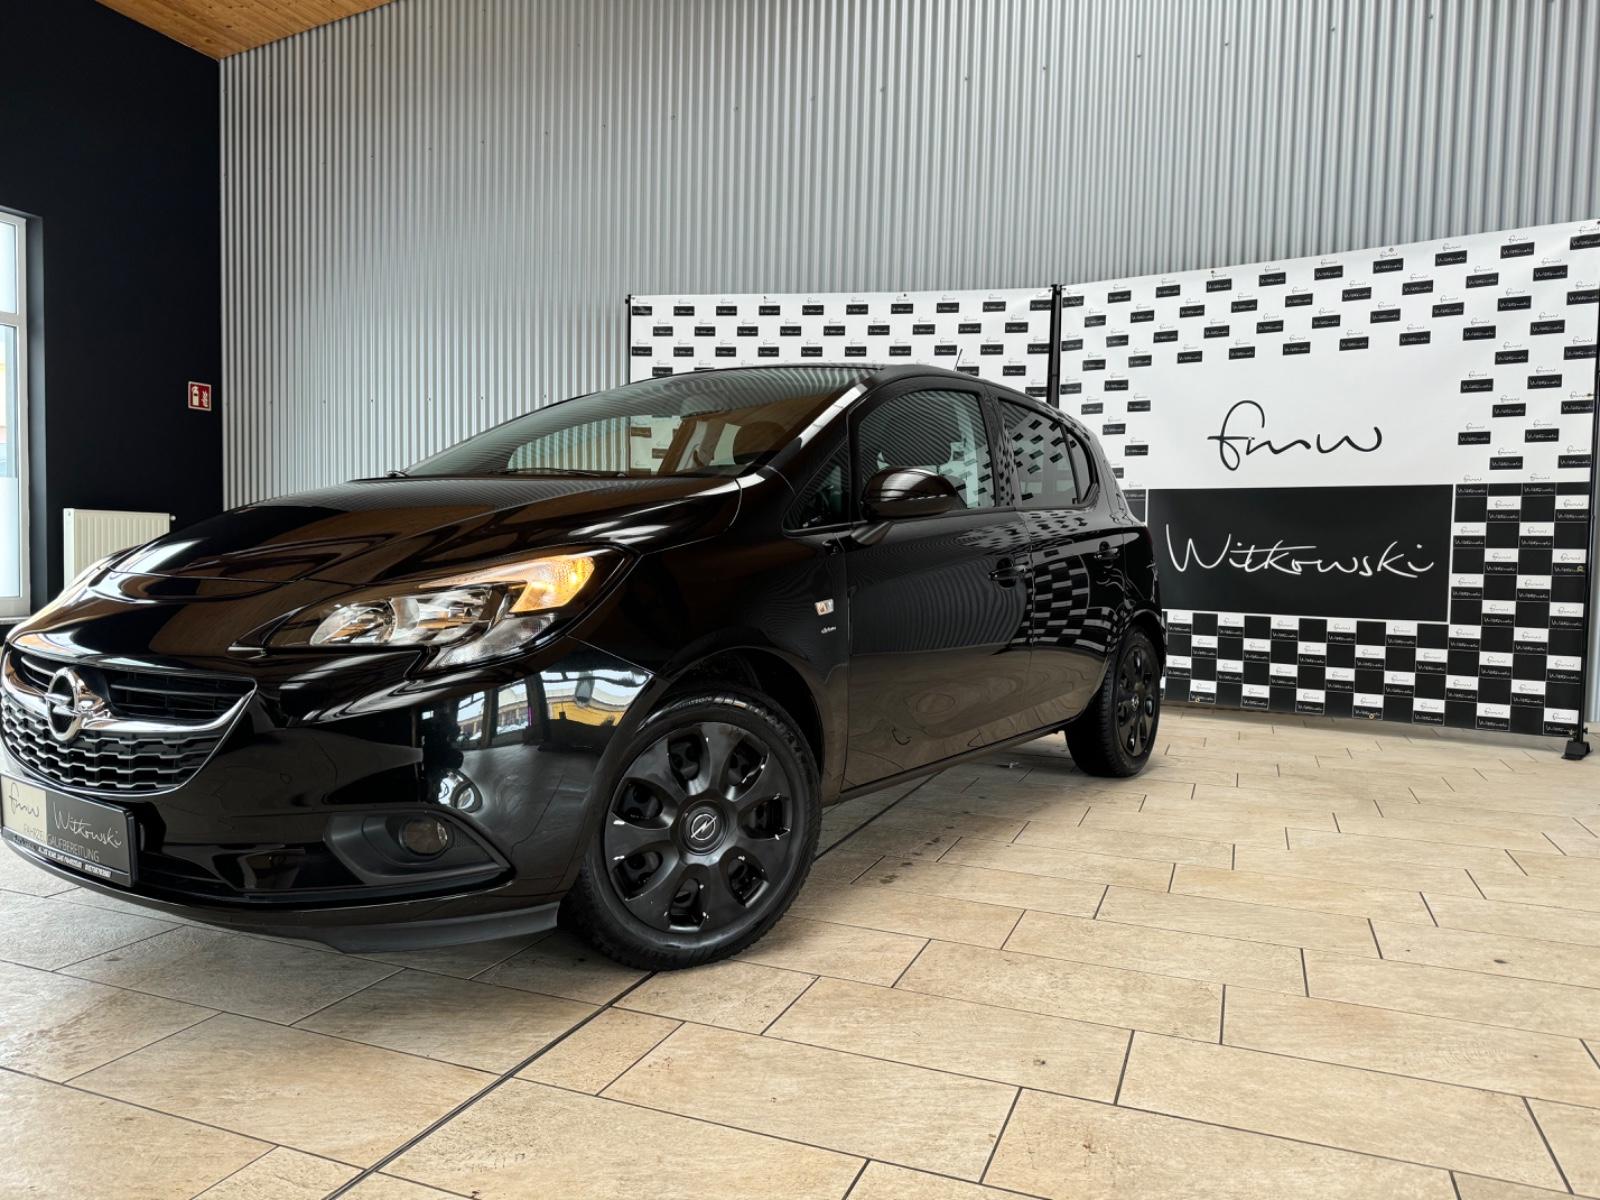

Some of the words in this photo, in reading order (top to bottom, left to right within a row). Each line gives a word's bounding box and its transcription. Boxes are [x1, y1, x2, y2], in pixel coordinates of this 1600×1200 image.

[1207, 400, 1382, 471] fmw
[1165, 523, 1435, 579] Witkowski
[8, 782, 40, 818] fmw
[53, 802, 122, 849] Witkowski
